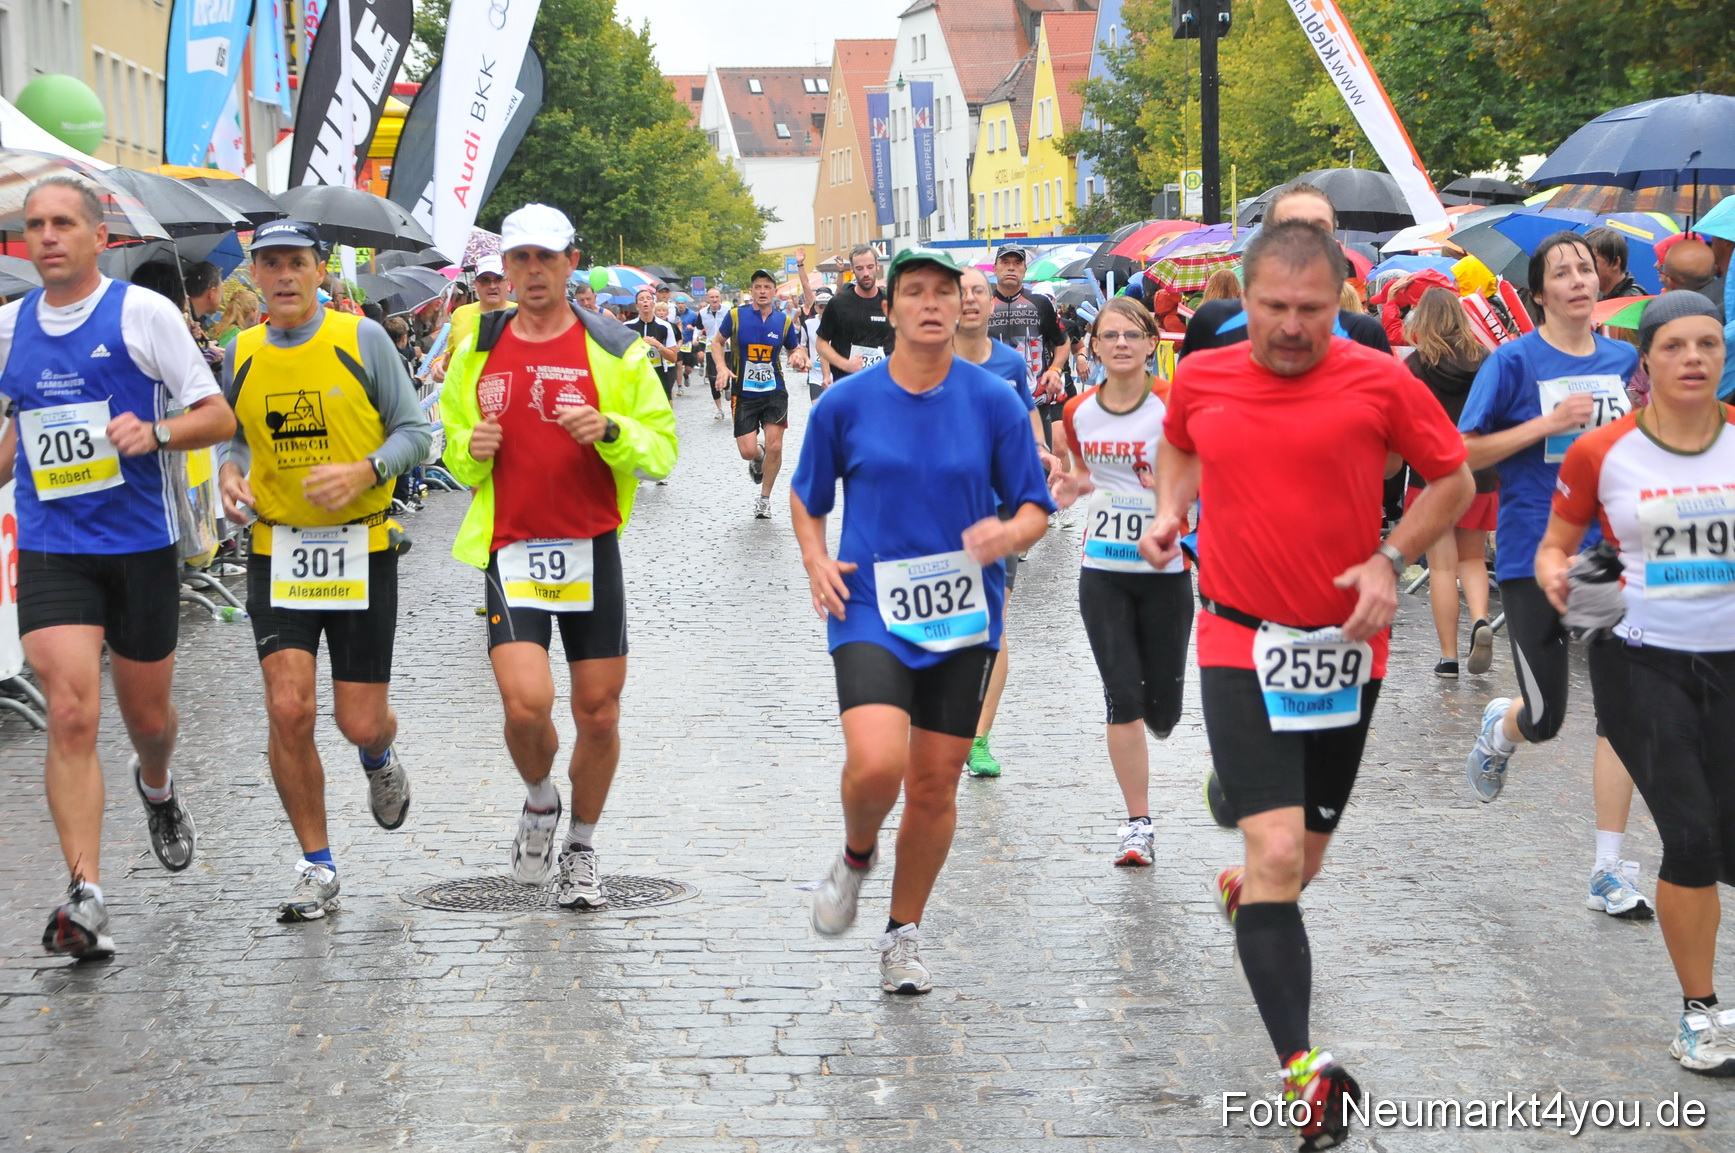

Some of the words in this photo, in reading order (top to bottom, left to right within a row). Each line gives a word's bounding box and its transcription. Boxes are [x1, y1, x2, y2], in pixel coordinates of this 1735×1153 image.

[372, 45, 394, 93] SWEDEN
[453, 130, 482, 210] Audi
[470, 54, 497, 123] BKK
[922, 133, 933, 181] RUPPERT
[536, 372, 578, 382] STADTLAUF
[537, 365, 589, 377] NEUMARKTER
[748, 369, 772, 382] 2463
[480, 393, 503, 406] NEU
[38, 428, 95, 466] 203
[274, 440, 329, 453] HIRSCH
[1083, 441, 1147, 456] MERZ
[50, 468, 92, 485] Robert
[1094, 510, 1155, 542] 219
[1654, 520, 1735, 556] 219
[292, 547, 346, 578] 301
[1105, 545, 1140, 560] Nadin
[528, 549, 566, 581] 59
[288, 585, 350, 597] Alexander
[890, 576, 976, 621] 3032
[924, 623, 952, 639] Cilli
[1265, 647, 1363, 690] 2559
